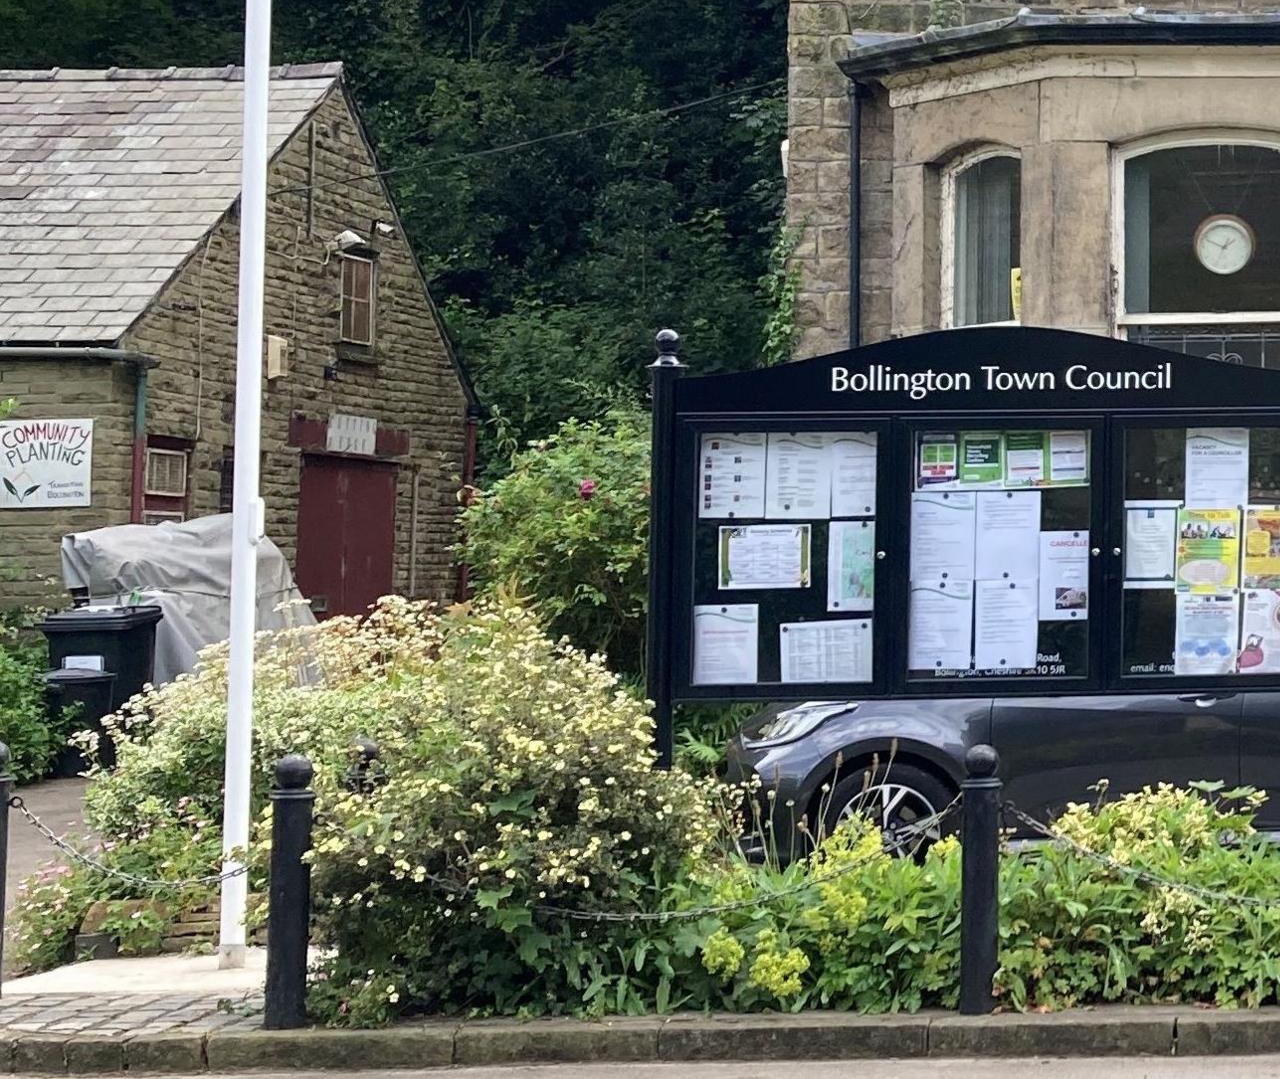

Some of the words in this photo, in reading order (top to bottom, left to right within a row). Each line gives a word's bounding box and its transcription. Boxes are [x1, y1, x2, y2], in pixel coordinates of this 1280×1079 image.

[831, 364, 971, 400] Bollington
[981, 366, 1055, 390] Town
[1065, 363, 1172, 390] Council
[2, 422, 92, 451] COMMUNITY
[6, 441, 87, 468] PLANTING
[1037, 653, 1062, 663] Road,
[1130, 662, 1157, 672] email:
[1050, 664, 1066, 675] 5JR
